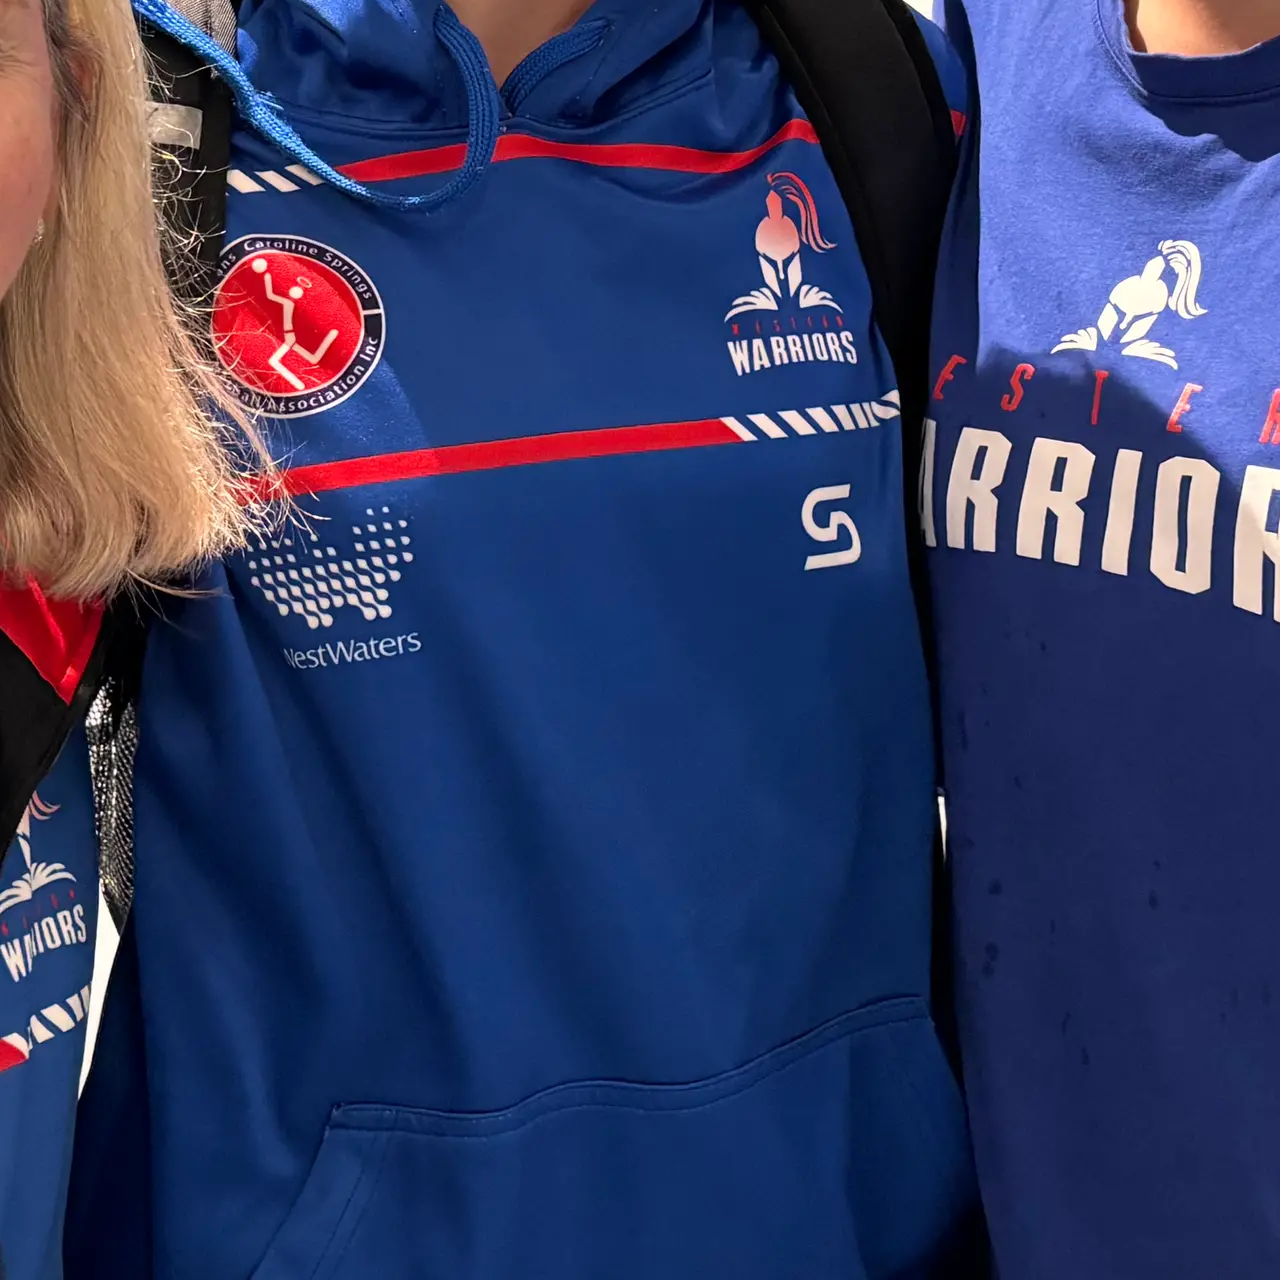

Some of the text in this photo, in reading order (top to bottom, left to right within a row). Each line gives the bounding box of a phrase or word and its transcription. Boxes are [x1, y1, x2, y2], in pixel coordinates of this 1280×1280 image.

[244, 240, 372, 299] Caroline Springs
[360, 337, 379, 362] Inc
[727, 330, 858, 376] WARRIORS
